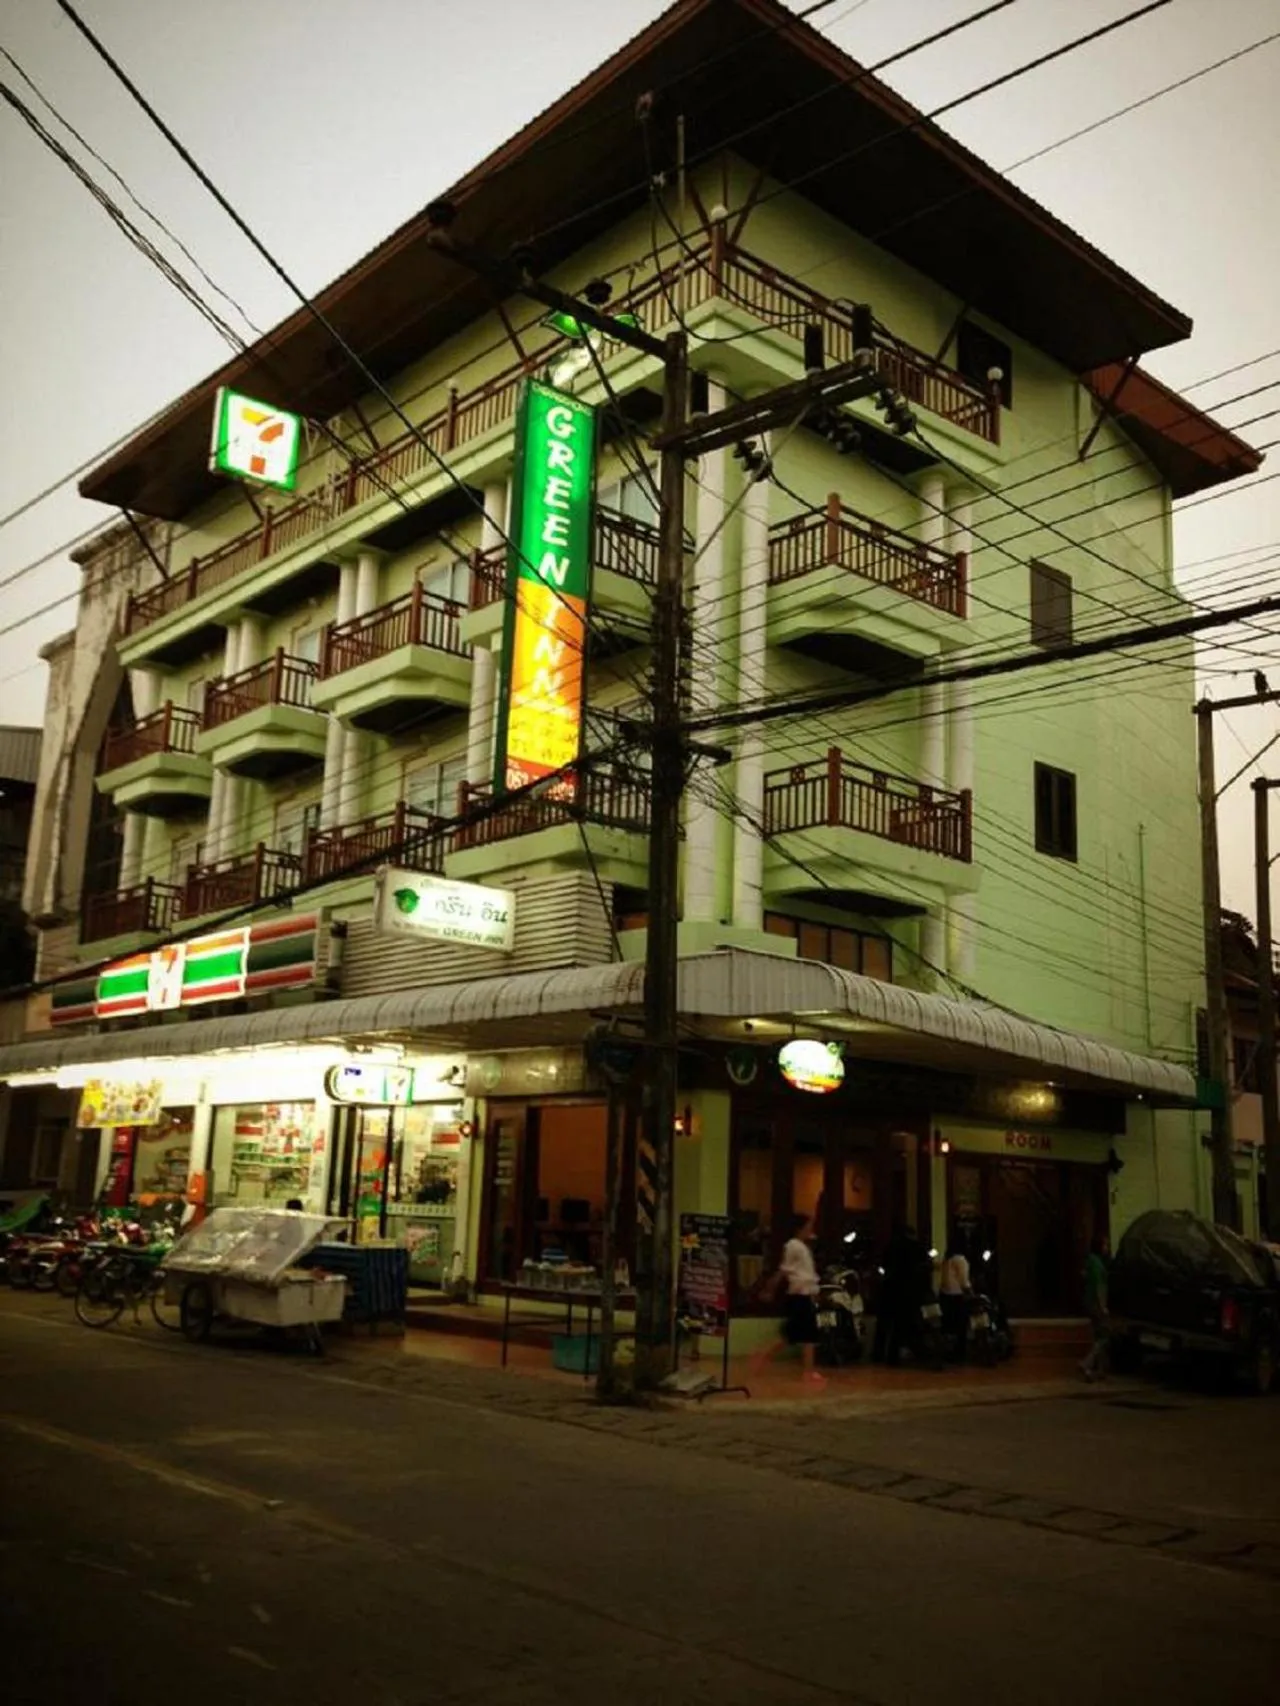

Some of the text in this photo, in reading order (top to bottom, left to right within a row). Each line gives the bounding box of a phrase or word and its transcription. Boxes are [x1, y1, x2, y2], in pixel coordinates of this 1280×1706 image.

[538, 406, 576, 586] GREEN
[530, 593, 569, 698] INN
[442, 927, 483, 942] GREEN
[1005, 1130, 1051, 1151] ROOM
